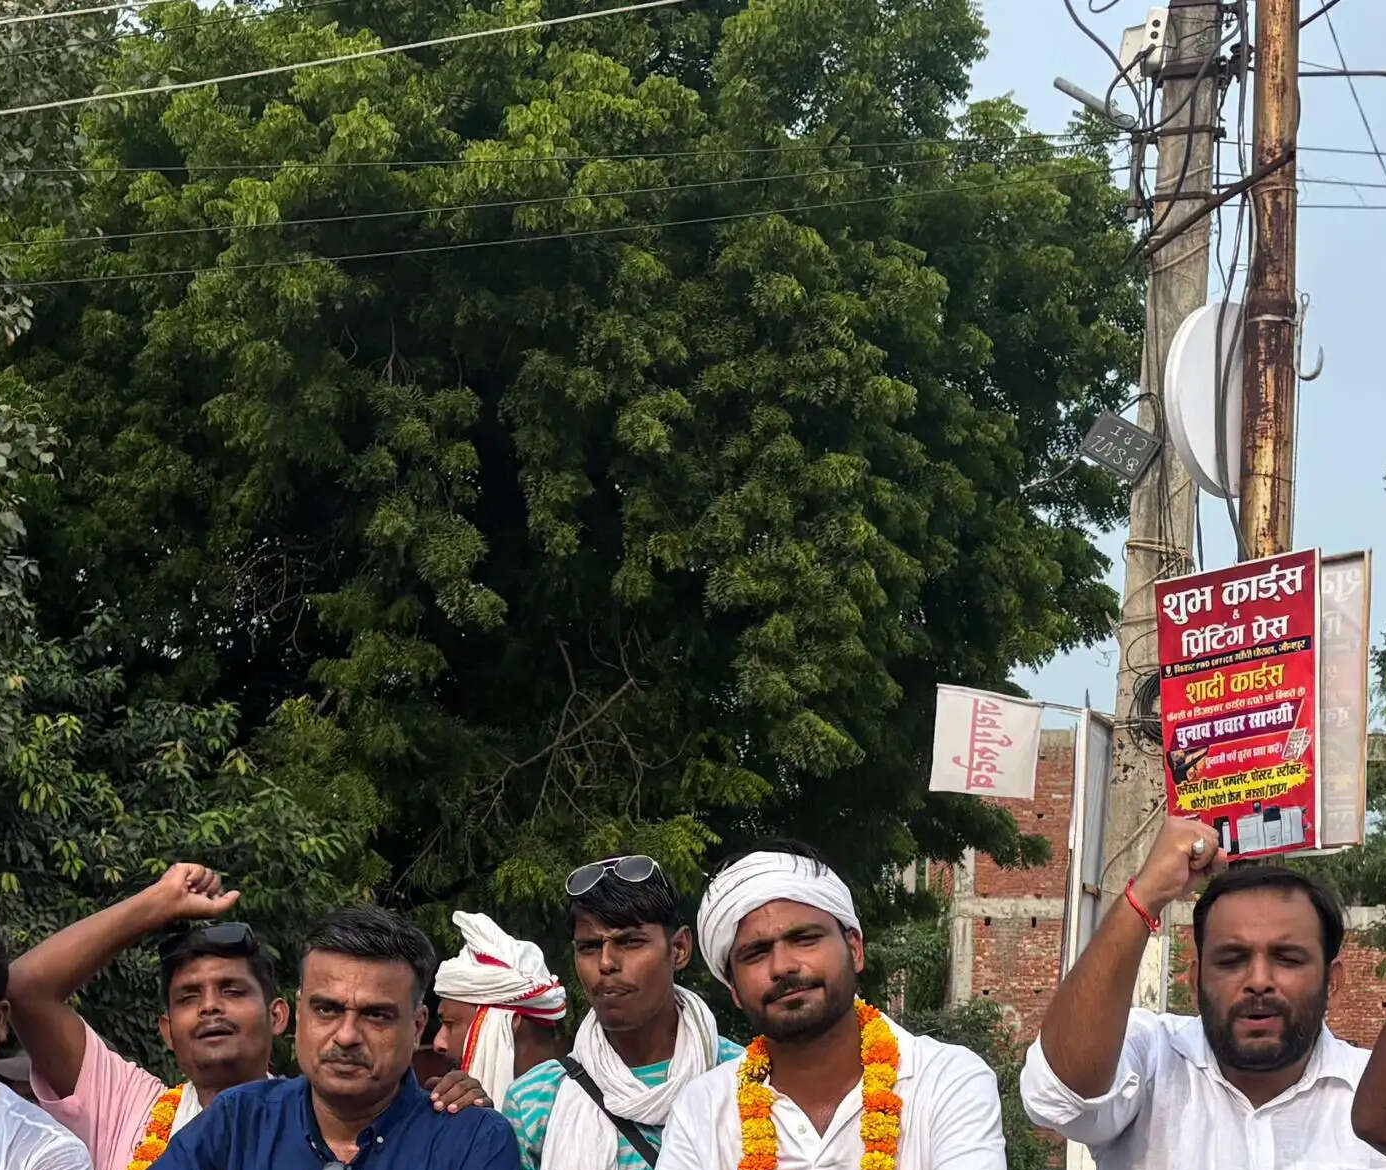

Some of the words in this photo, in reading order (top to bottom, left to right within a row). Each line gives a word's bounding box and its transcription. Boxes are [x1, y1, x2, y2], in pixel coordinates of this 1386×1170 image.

[1163, 585, 1214, 625] शुभ
[1222, 564, 1305, 606] कार्ड्स
[1181, 622, 1245, 658] प्रिंटिंग
[1252, 615, 1290, 645] प्रेस
[1185, 671, 1226, 704] शादी
[1176, 722, 1212, 749] चुनाव
[1213, 715, 1246, 738] प्रचार
[1247, 702, 1294, 729] सामग्री
